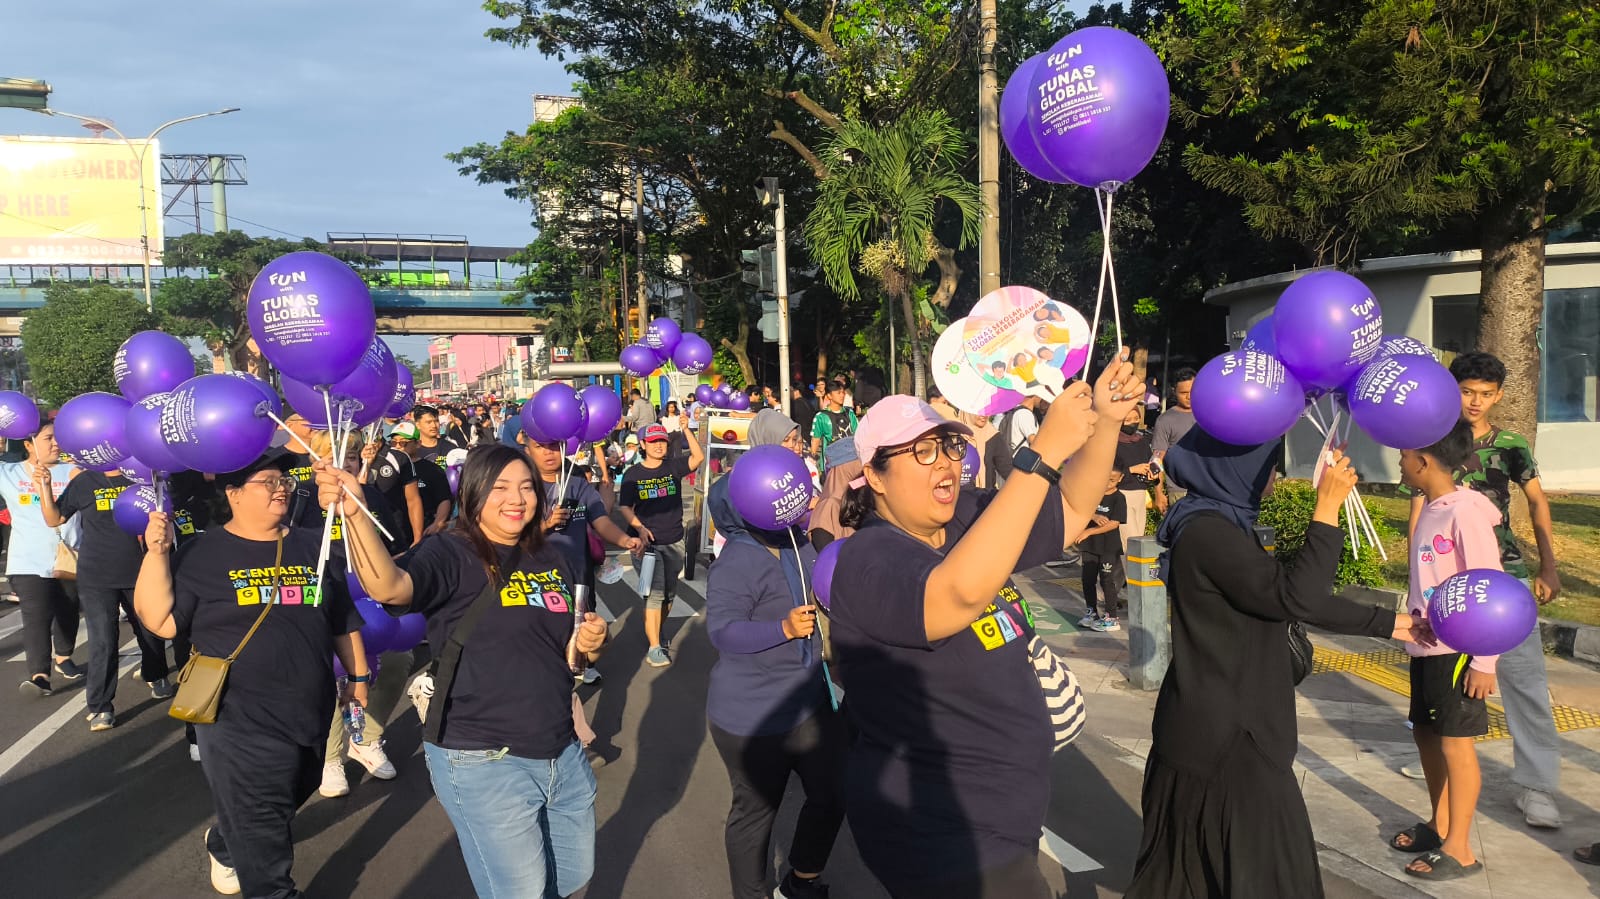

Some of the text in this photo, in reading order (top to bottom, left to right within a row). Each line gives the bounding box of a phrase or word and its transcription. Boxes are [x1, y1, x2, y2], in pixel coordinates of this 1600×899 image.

[1047, 44, 1082, 67] FUN
[1056, 63, 1069, 71] with
[1038, 65, 1096, 98] TUNAS
[1040, 80, 1098, 111] GLOBAL
[17, 193, 71, 217] HERE
[269, 271, 307, 286] FUN
[261, 294, 319, 312] TUNAS
[263, 307, 320, 323] GLOBAL
[1350, 297, 1375, 316] FUN
[968, 328, 994, 347] TUNAS
[992, 307, 1022, 331] SEKOLAH
[995, 299, 1045, 336] KEBERAGAMAN
[1351, 316, 1382, 340] TUNAS
[1401, 336, 1425, 355] TUN
[1222, 354, 1236, 376] FUN
[1245, 351, 1257, 381] TUNAS
[1256, 353, 1267, 384] GLOBAL
[1364, 361, 1398, 399] GLOBAL
[1372, 365, 1408, 403] TUNAS
[1393, 380, 1419, 405] FUN
[167, 393, 180, 442] GLOBAL
[770, 471, 794, 491] FUN
[133, 500, 151, 513] FUN
[771, 482, 806, 509] TUNAS
[775, 492, 809, 516] GLOBAL
[1421, 552, 1433, 562] 66
[249, 578, 272, 586] ME
[1456, 574, 1470, 612] TUNAS
[1474, 579, 1490, 603] FUN
[1447, 576, 1458, 615] GLOBAL
